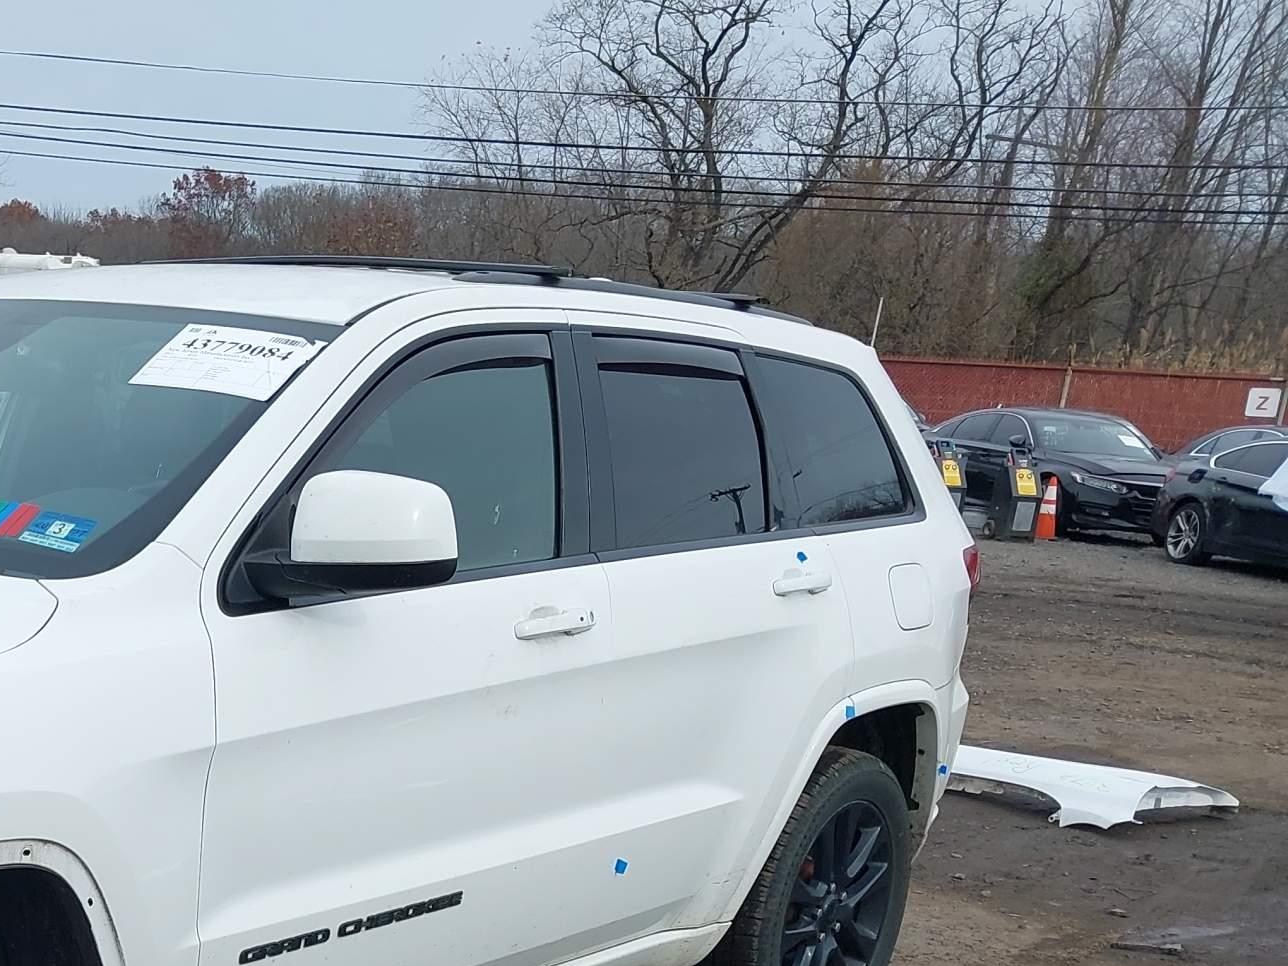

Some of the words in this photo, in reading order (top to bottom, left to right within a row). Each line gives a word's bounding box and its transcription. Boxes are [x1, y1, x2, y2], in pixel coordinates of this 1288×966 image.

[182, 337, 294, 361] 43779084
[1256, 396, 1270, 410] Z
[53, 522, 66, 535] 3
[238, 927, 331, 965] GRAND
[337, 890, 464, 938] CHEROKEE
